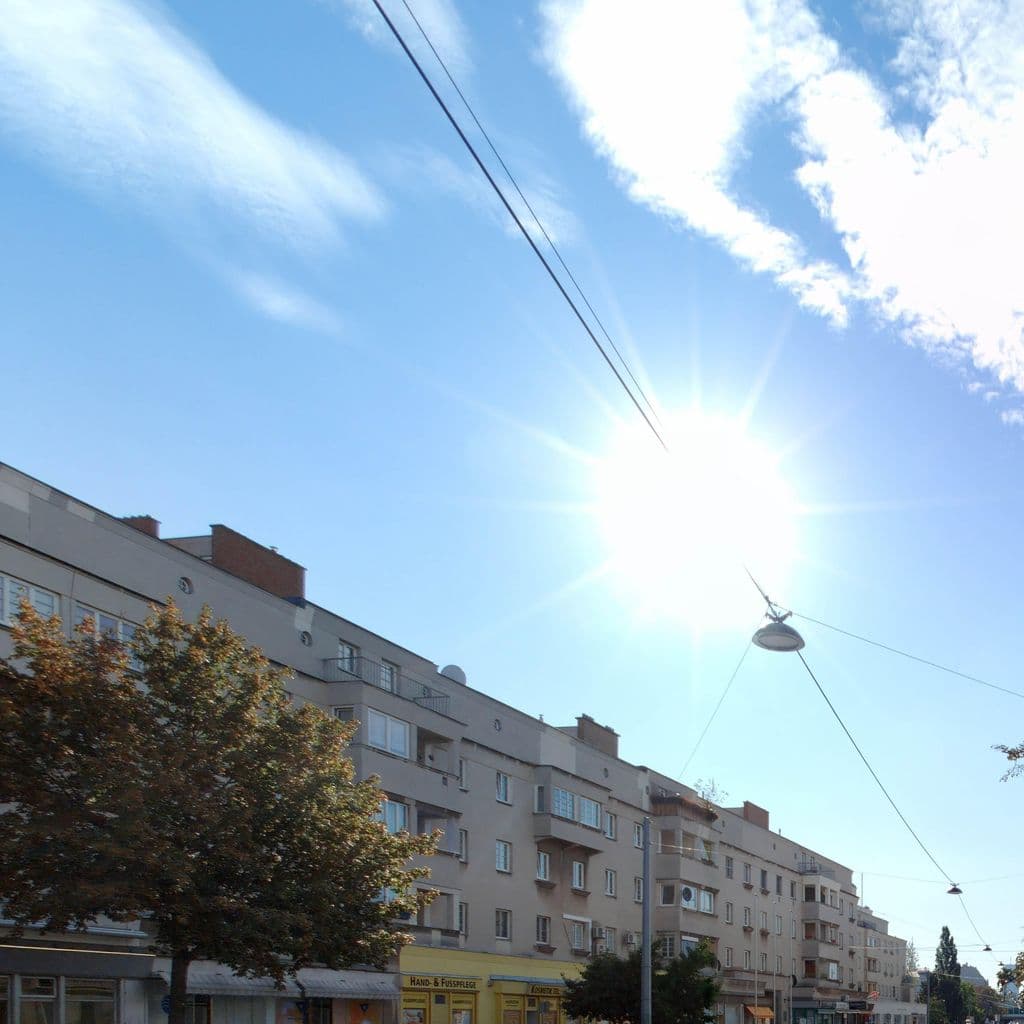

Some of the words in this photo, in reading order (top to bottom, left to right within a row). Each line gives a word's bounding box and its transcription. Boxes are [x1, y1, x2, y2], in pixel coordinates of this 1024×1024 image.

[410, 976, 431, 987] HAND-
[433, 977, 439, 987] &
[441, 978, 477, 989] FUSSPFLEGE
